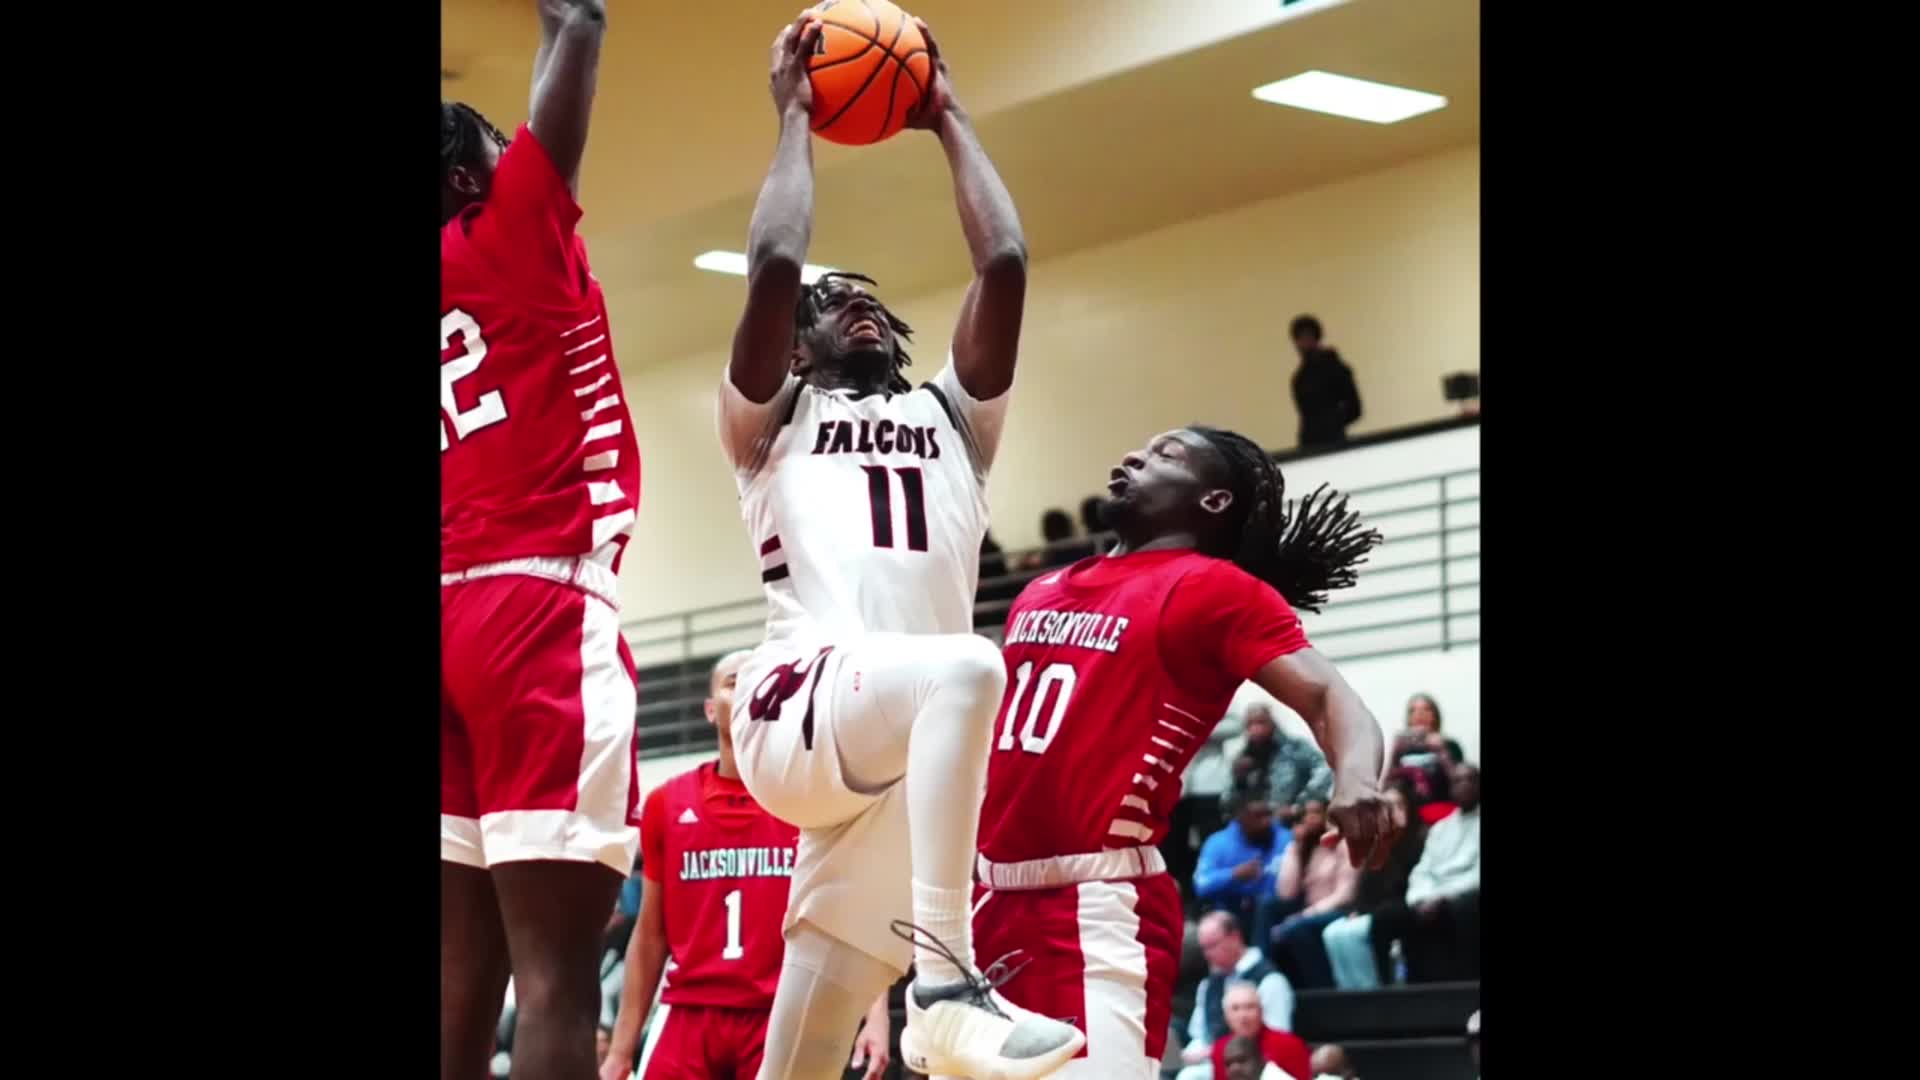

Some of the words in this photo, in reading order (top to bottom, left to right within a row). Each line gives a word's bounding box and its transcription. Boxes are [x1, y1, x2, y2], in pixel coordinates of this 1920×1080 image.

[811, 419, 940, 459] FALCONS
[859, 465, 928, 552] 11
[998, 661, 1077, 754] 10
[679, 848, 793, 880] JACKSONVILLE
[722, 889, 744, 960] 1
